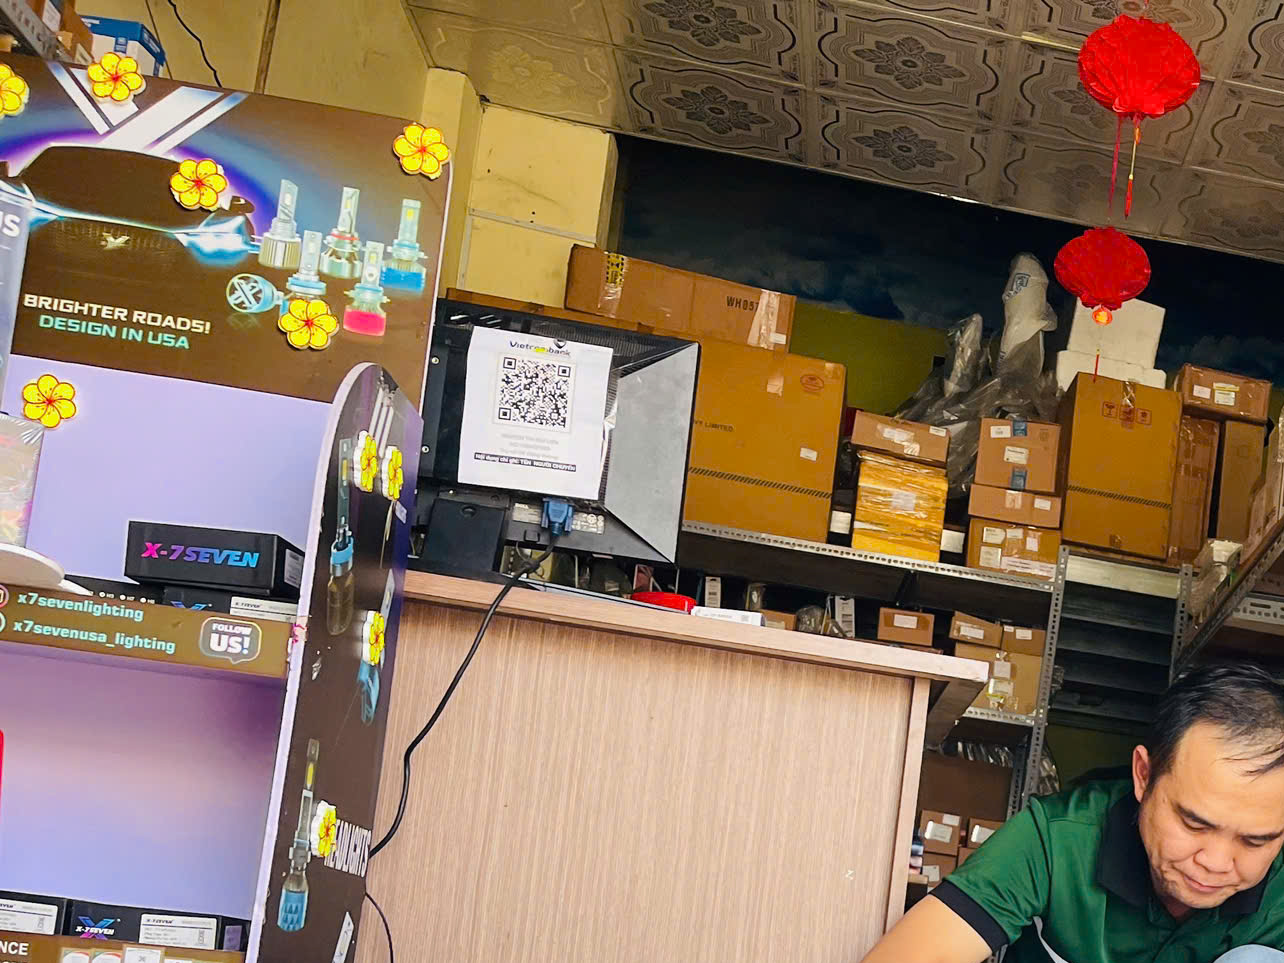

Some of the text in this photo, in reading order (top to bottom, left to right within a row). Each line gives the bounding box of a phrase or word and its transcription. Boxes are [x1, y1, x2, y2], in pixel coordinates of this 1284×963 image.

[23, 293, 212, 335] BRIGHTER ROADS!
[39, 314, 190, 350] DESIGN IN USA
[141, 542, 260, 568] X-7SEVEN
[17, 591, 145, 622] x7sevenlighting
[12, 619, 177, 655] x7sevenusa_lighting
[209, 632, 251, 655] US!
[211, 622, 253, 635] FOLLOW
